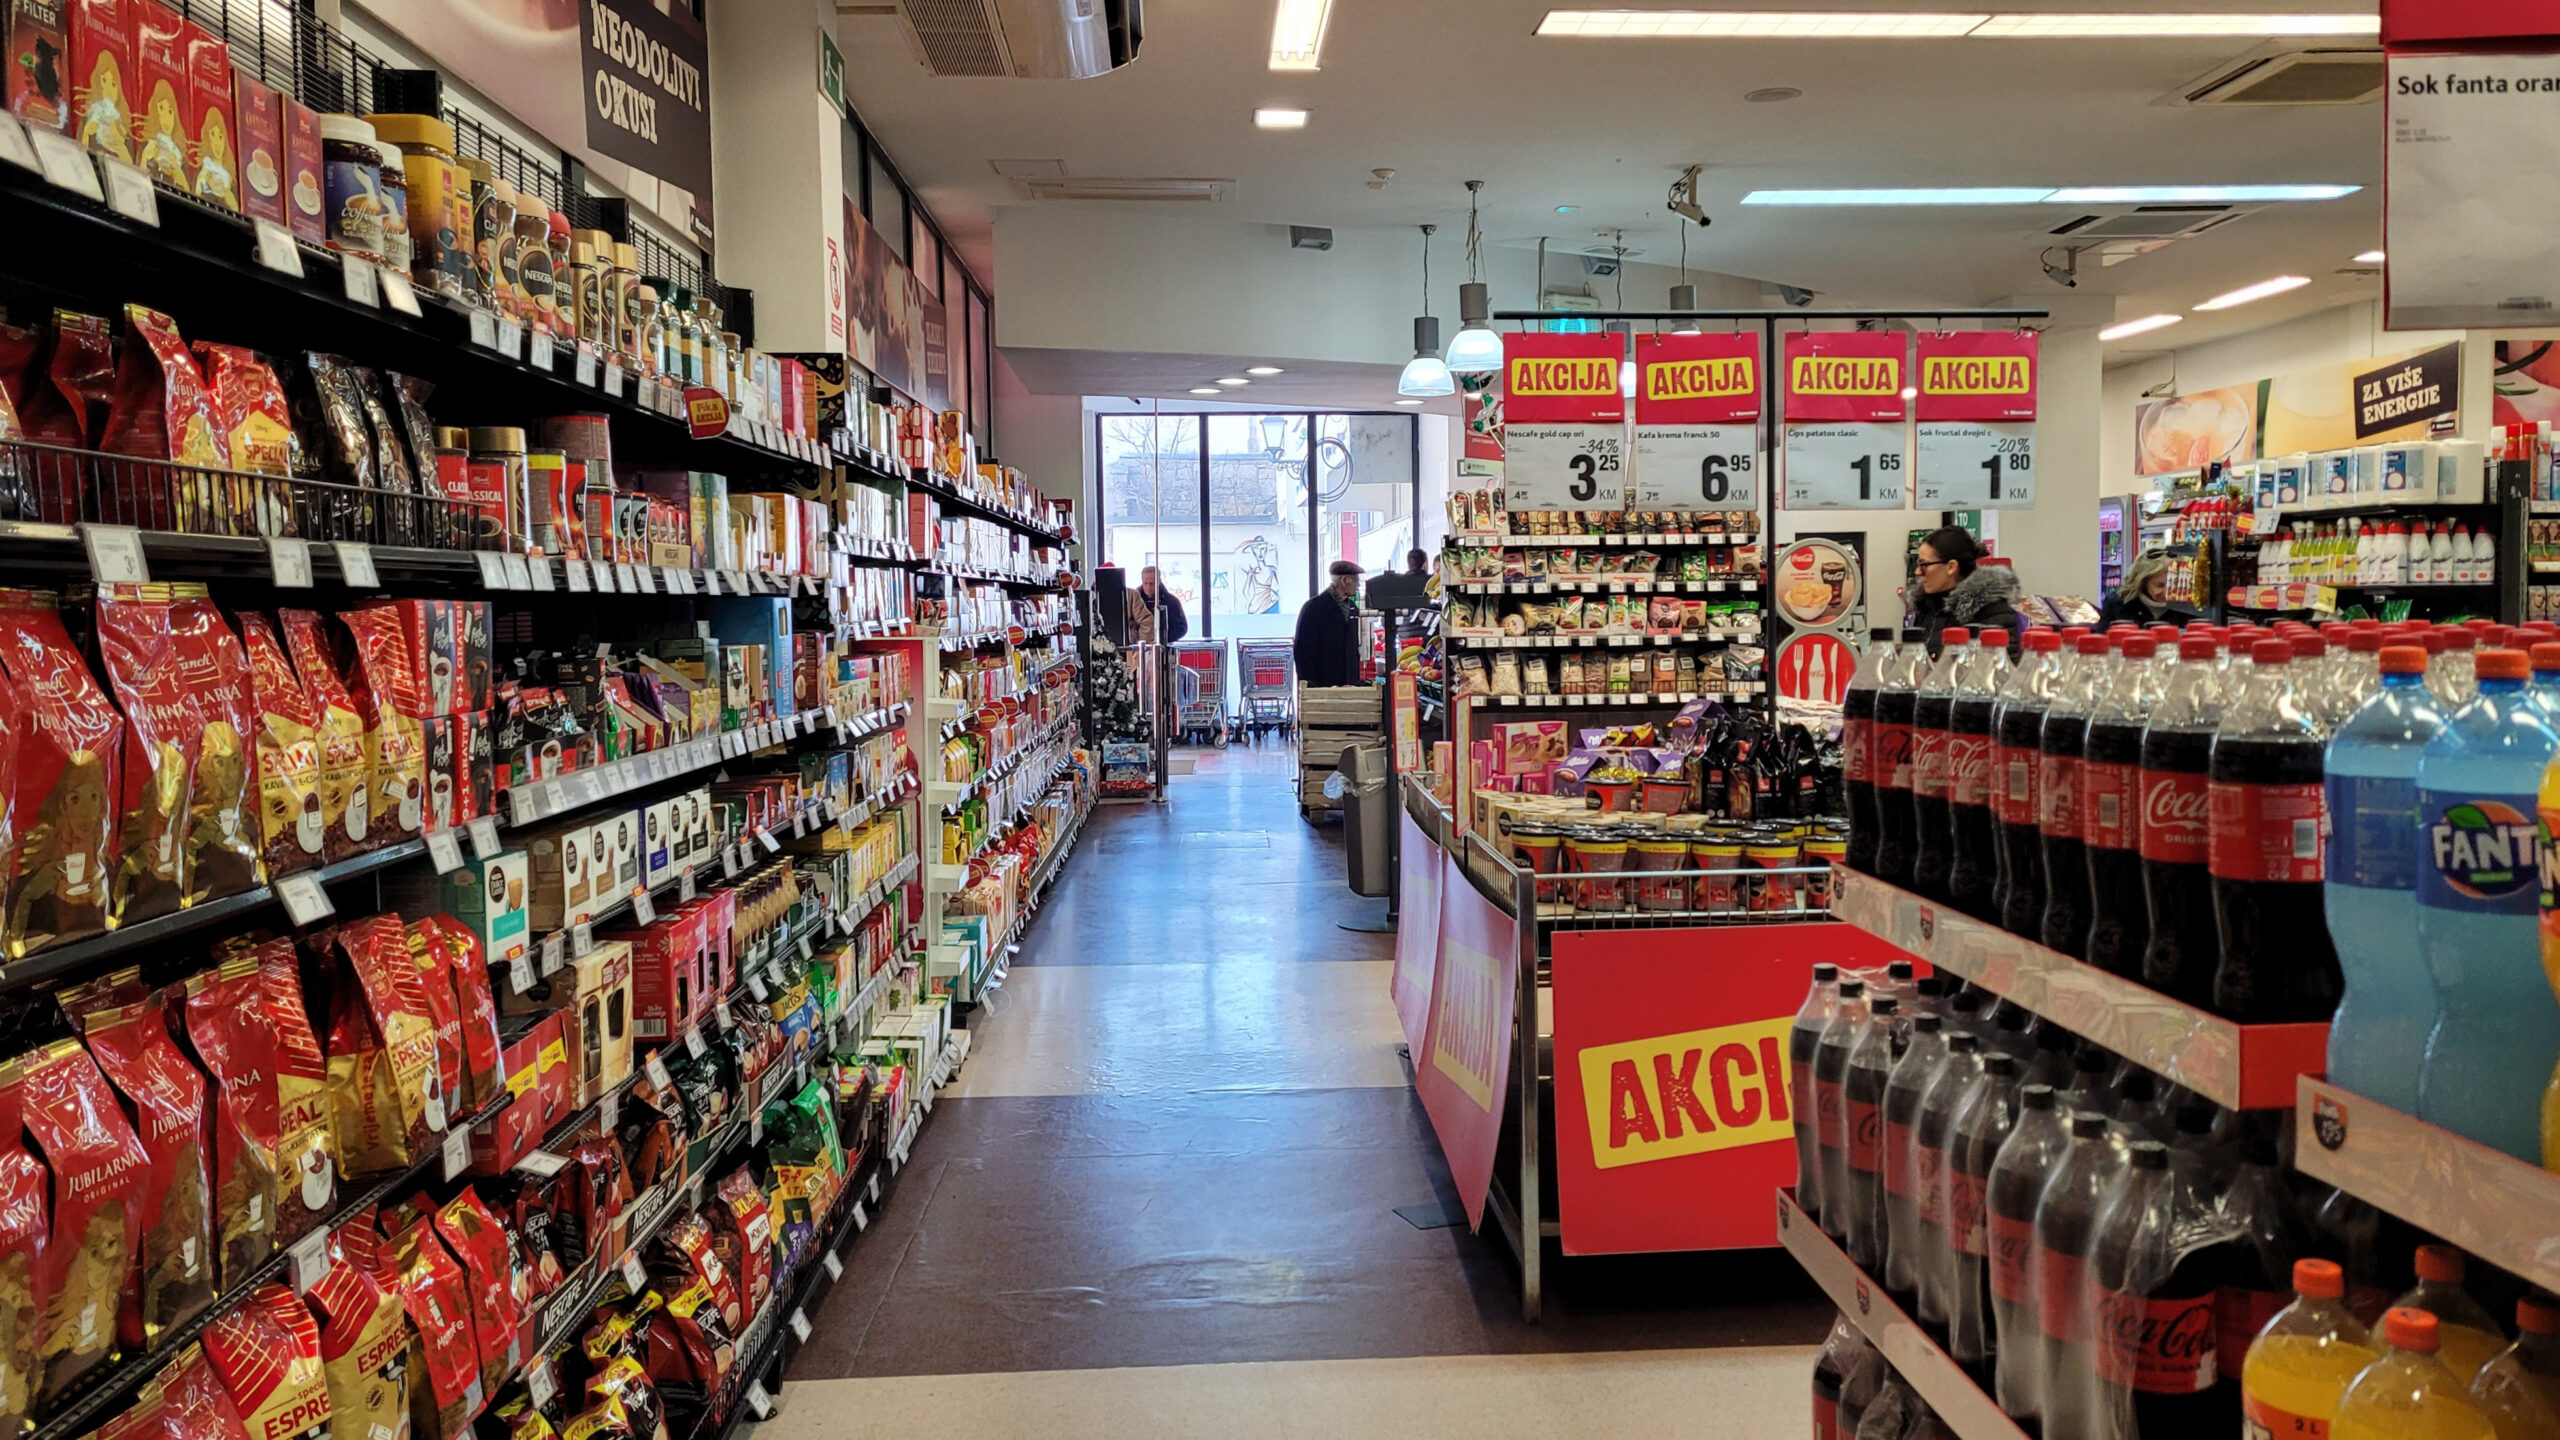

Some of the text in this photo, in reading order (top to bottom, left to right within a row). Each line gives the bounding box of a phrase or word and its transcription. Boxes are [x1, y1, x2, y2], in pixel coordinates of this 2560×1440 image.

[23, 2, 57, 28] FILTER
[591, 0, 702, 112] NEODOLJIVI
[2397, 73, 2439, 95] Sok
[2446, 73, 2509, 95] fanta
[595, 69, 658, 145] OKUSI
[1517, 362, 1612, 391] AKCIJA
[1653, 362, 1748, 396] AKCIJA
[1798, 362, 1893, 391] AKCIJA
[1929, 362, 2024, 390] AKCIJA
[2362, 365, 2423, 403] ZA VIŠE
[695, 411, 723, 425] AKCIJA
[696, 401, 719, 415] Pika
[2363, 384, 2441, 425] ENERGIJE
[1507, 430, 1585, 439] Nescafe gold cap ori
[1578, 438, 1619, 454] -34%
[1638, 431, 1656, 439] Kafa
[1657, 431, 1682, 439] krema
[1837, 429, 1859, 437] clasic
[1919, 429, 1933, 437] Sok
[1935, 429, 1961, 437] fructal
[1962, 429, 1986, 438] dvojni
[1990, 437, 2030, 453] -20%
[1569, 454, 1619, 501] 3 25 KM
[1701, 454, 1751, 502] 6 95 KM
[1850, 453, 1900, 500] 1 65 KM
[1981, 453, 2030, 500] 1 80 KM
[2432, 824, 2540, 870] FANT
[1608, 1036, 1791, 1150] AKCI
[67, 1145, 141, 1200] JUBILARNA
[83, 1175, 132, 1203] ORIGINAL
